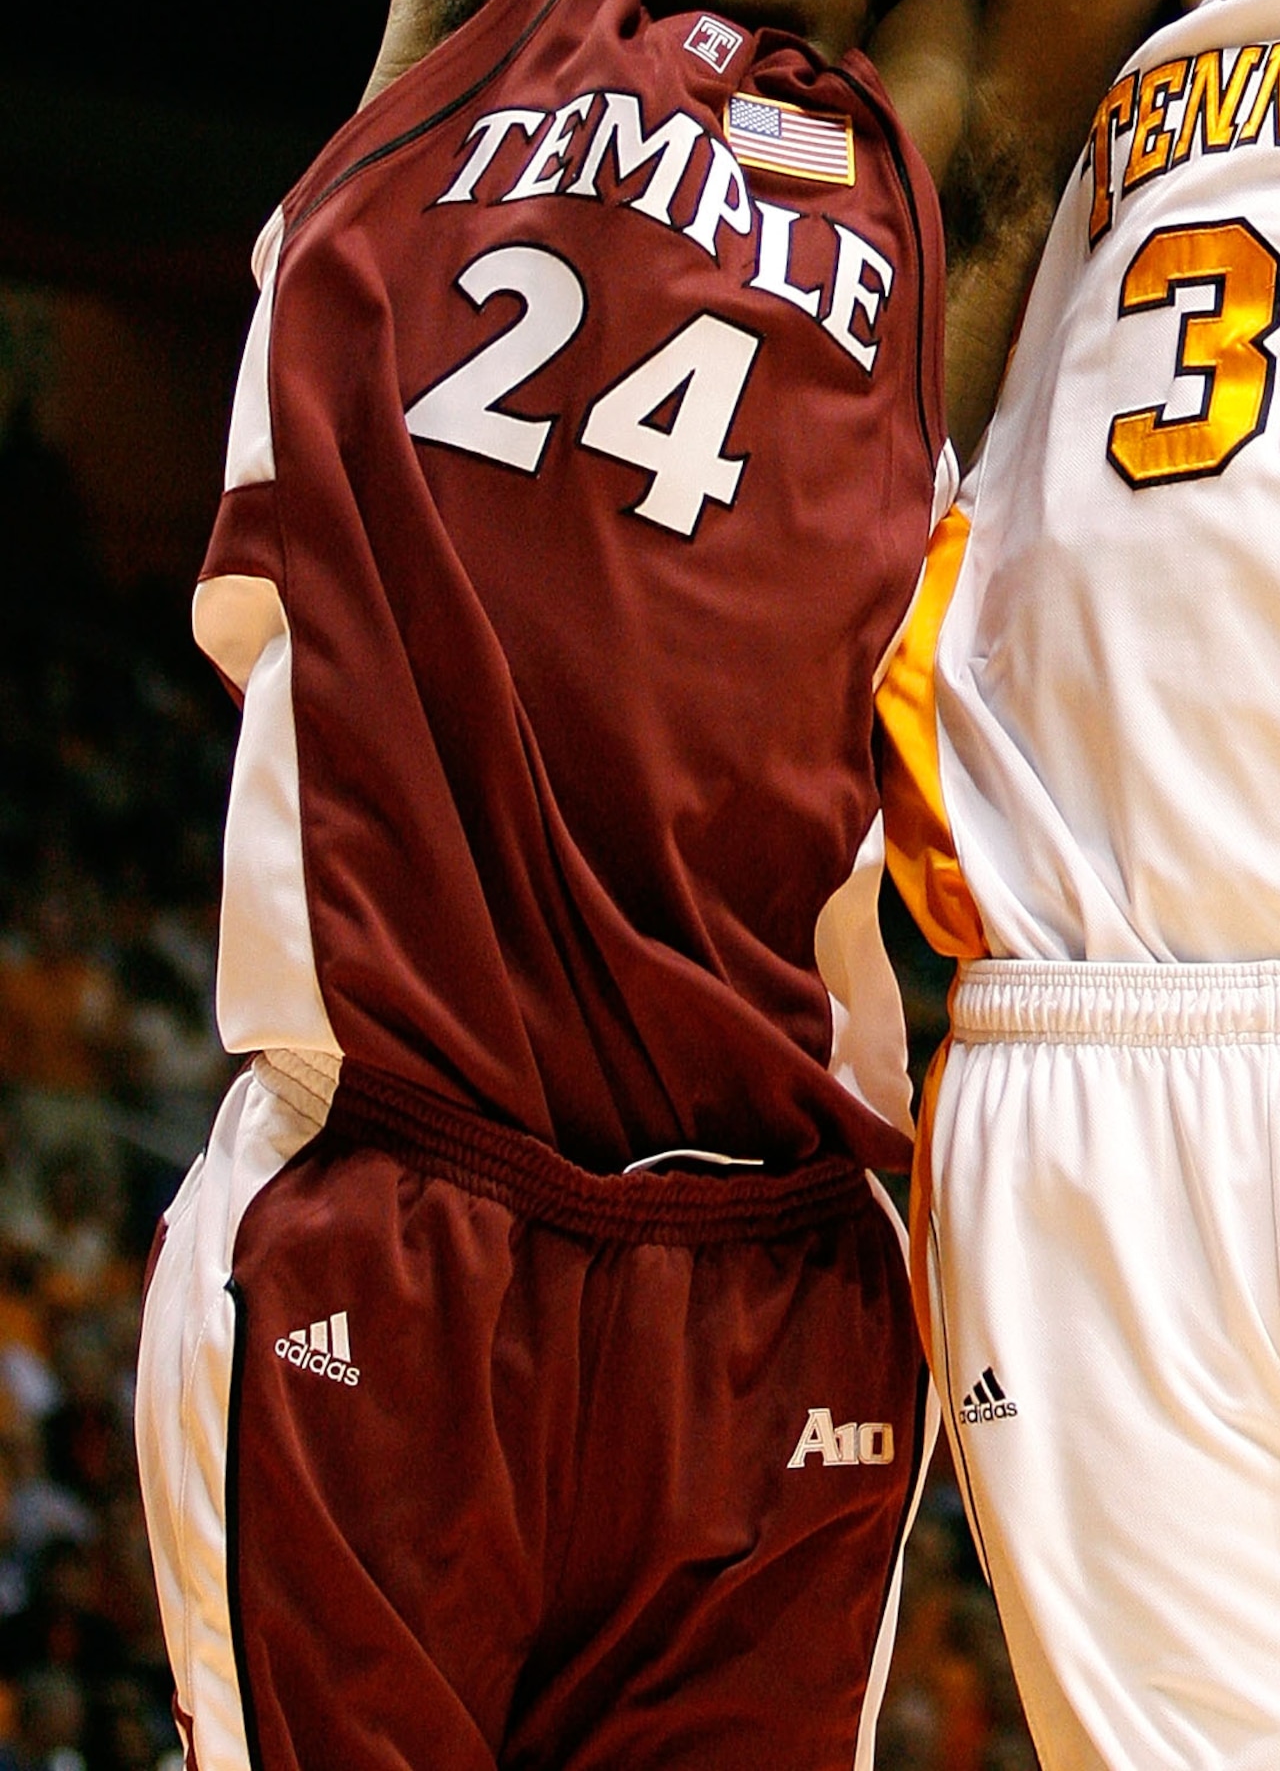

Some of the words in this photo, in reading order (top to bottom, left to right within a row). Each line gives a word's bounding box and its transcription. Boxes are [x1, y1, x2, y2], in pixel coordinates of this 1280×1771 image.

[424, 90, 896, 379] TEMPLE
[402, 239, 766, 541] 24
[274, 1337, 361, 1387] adidas
[786, 1407, 895, 1469] A10
[959, 1400, 1019, 1426] adidas
